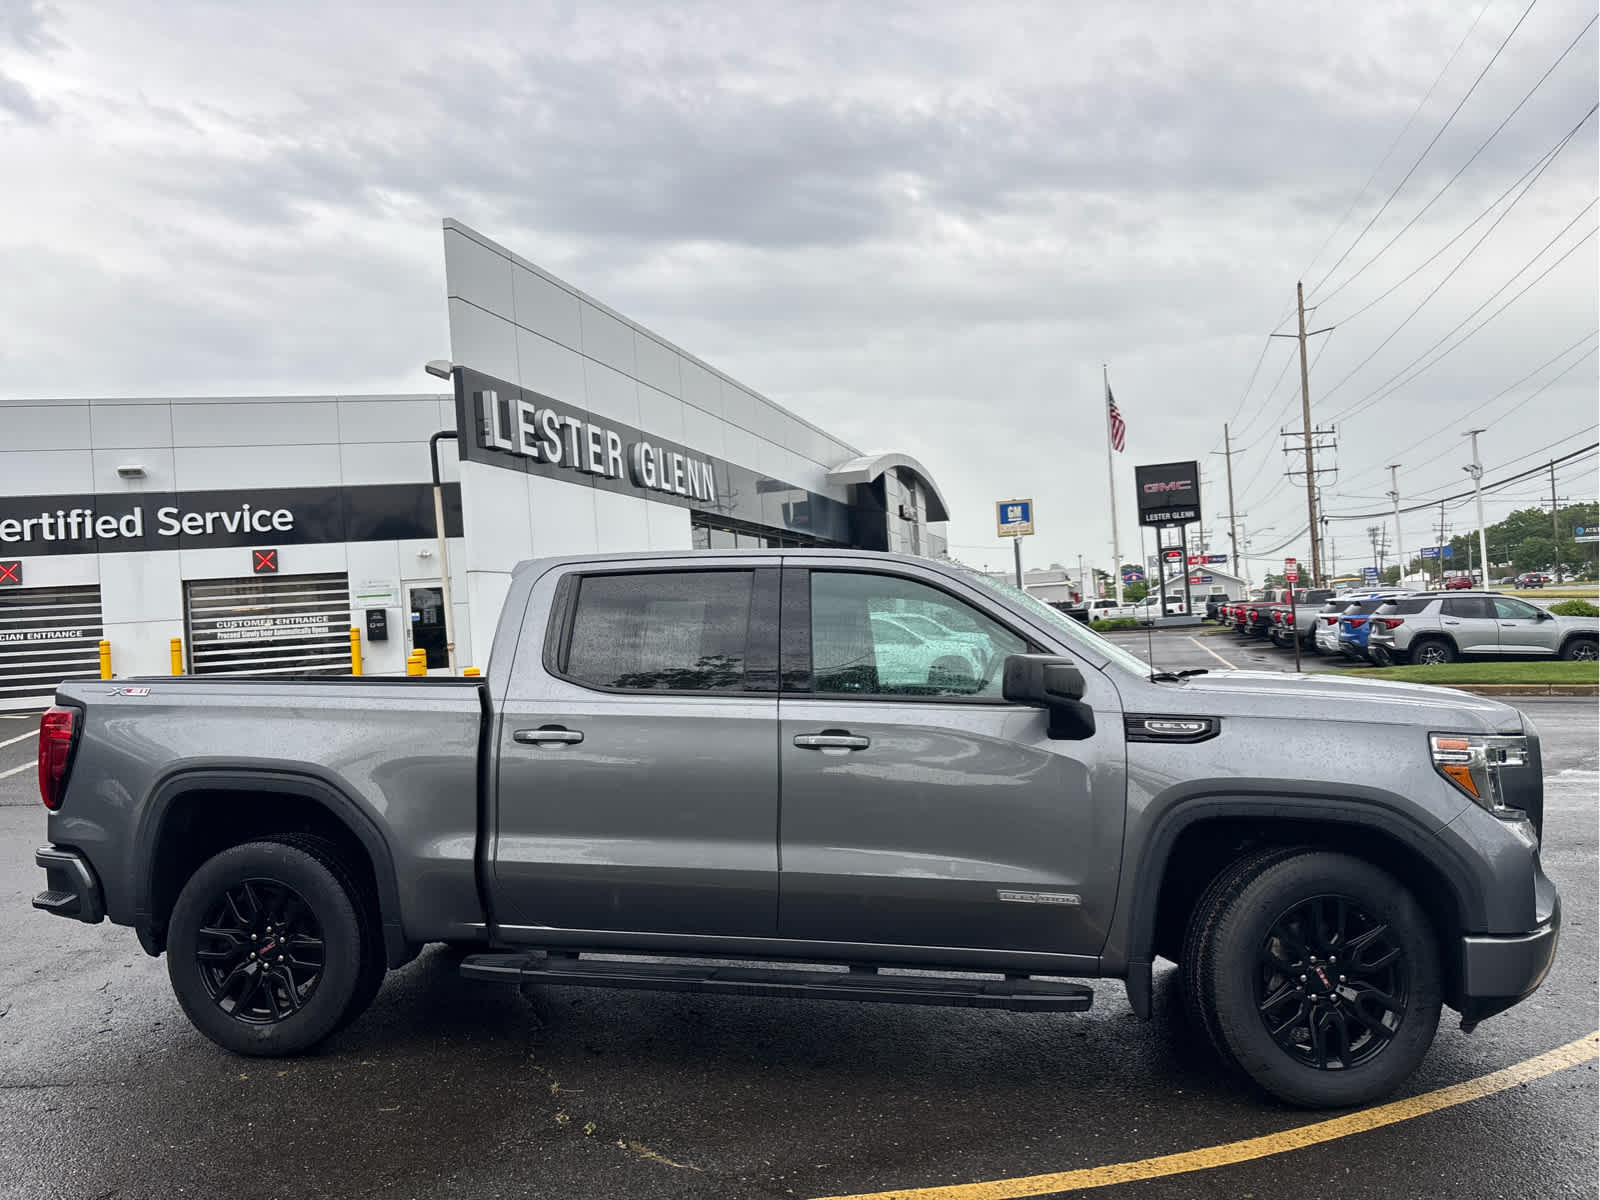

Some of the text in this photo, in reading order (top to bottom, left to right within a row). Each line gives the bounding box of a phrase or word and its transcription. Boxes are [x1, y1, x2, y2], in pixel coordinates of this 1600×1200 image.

[483, 389, 716, 501] LESTER GLENN
[1143, 480, 1192, 493] GMC
[1145, 510, 1195, 521] LESTER GLENN
[0, 503, 294, 542] ertified Service
[216, 616, 328, 628] CUSTOMER ENTRANCE
[27, 630, 83, 640] ENTRANCE
